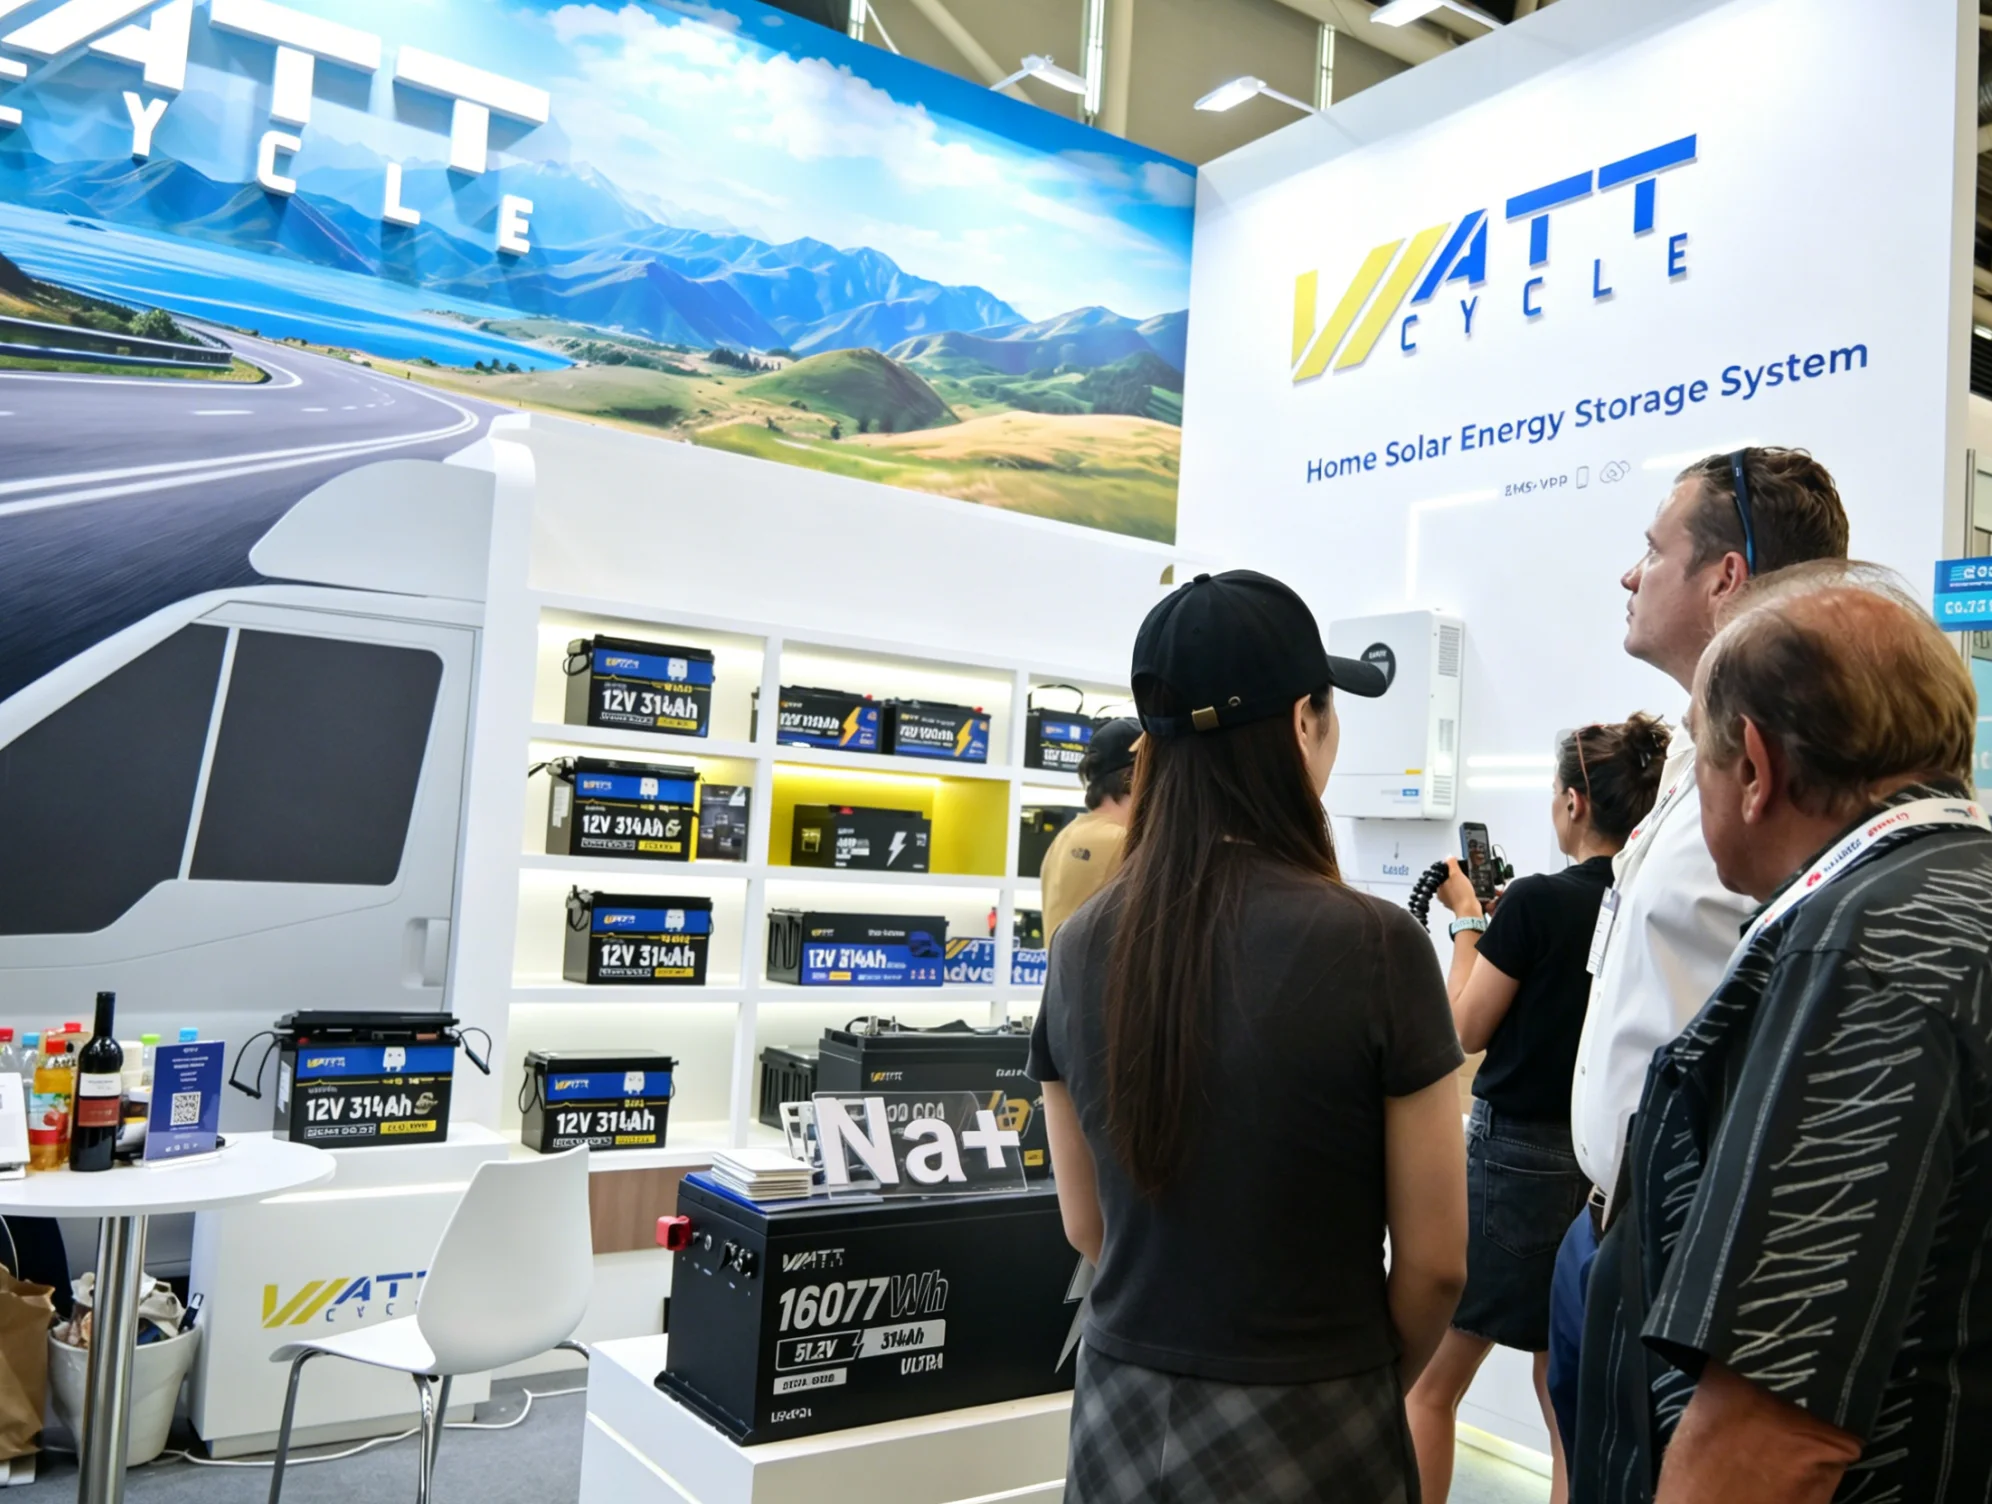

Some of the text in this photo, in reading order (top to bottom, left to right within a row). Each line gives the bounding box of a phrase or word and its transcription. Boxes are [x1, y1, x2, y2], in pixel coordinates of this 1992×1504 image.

[0, 0, 549, 175] ATT
[0, 57, 534, 257] YCLE
[1291, 133, 1698, 383] WATT
[1400, 232, 1689, 352] CYCLE
[1307, 343, 1869, 484] Home Solar Energy Storage System
[602, 689, 698, 719] 12V 314Ah
[582, 815, 665, 838] 12V 314Ah
[600, 944, 695, 968] 12V 314Ah
[808, 948, 837, 969] 12V
[306, 1093, 413, 1122] 12V 314Ah
[556, 1108, 656, 1135] 12V 314Ah
